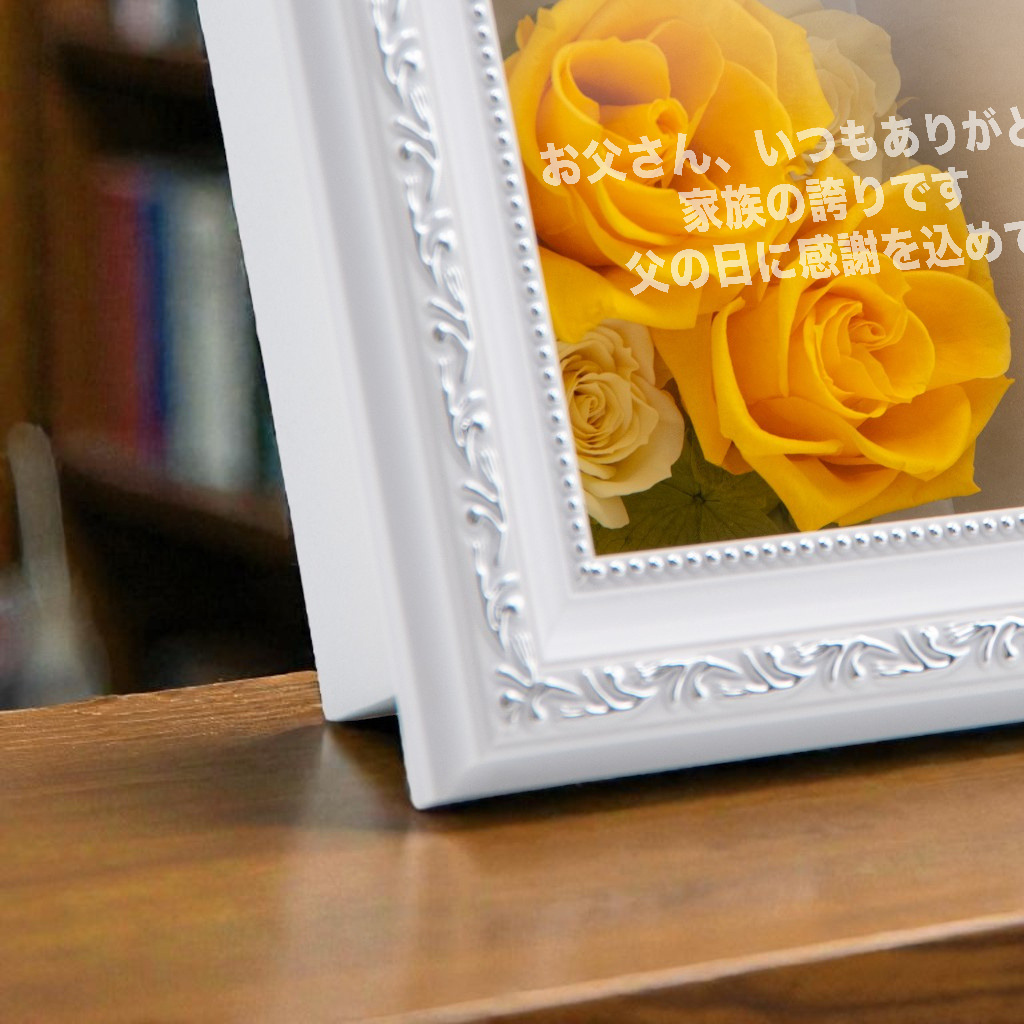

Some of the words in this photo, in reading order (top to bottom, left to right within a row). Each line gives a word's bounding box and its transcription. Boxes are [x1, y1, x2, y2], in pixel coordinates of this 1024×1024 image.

[677, 165, 969, 234] 家族の誇りです
